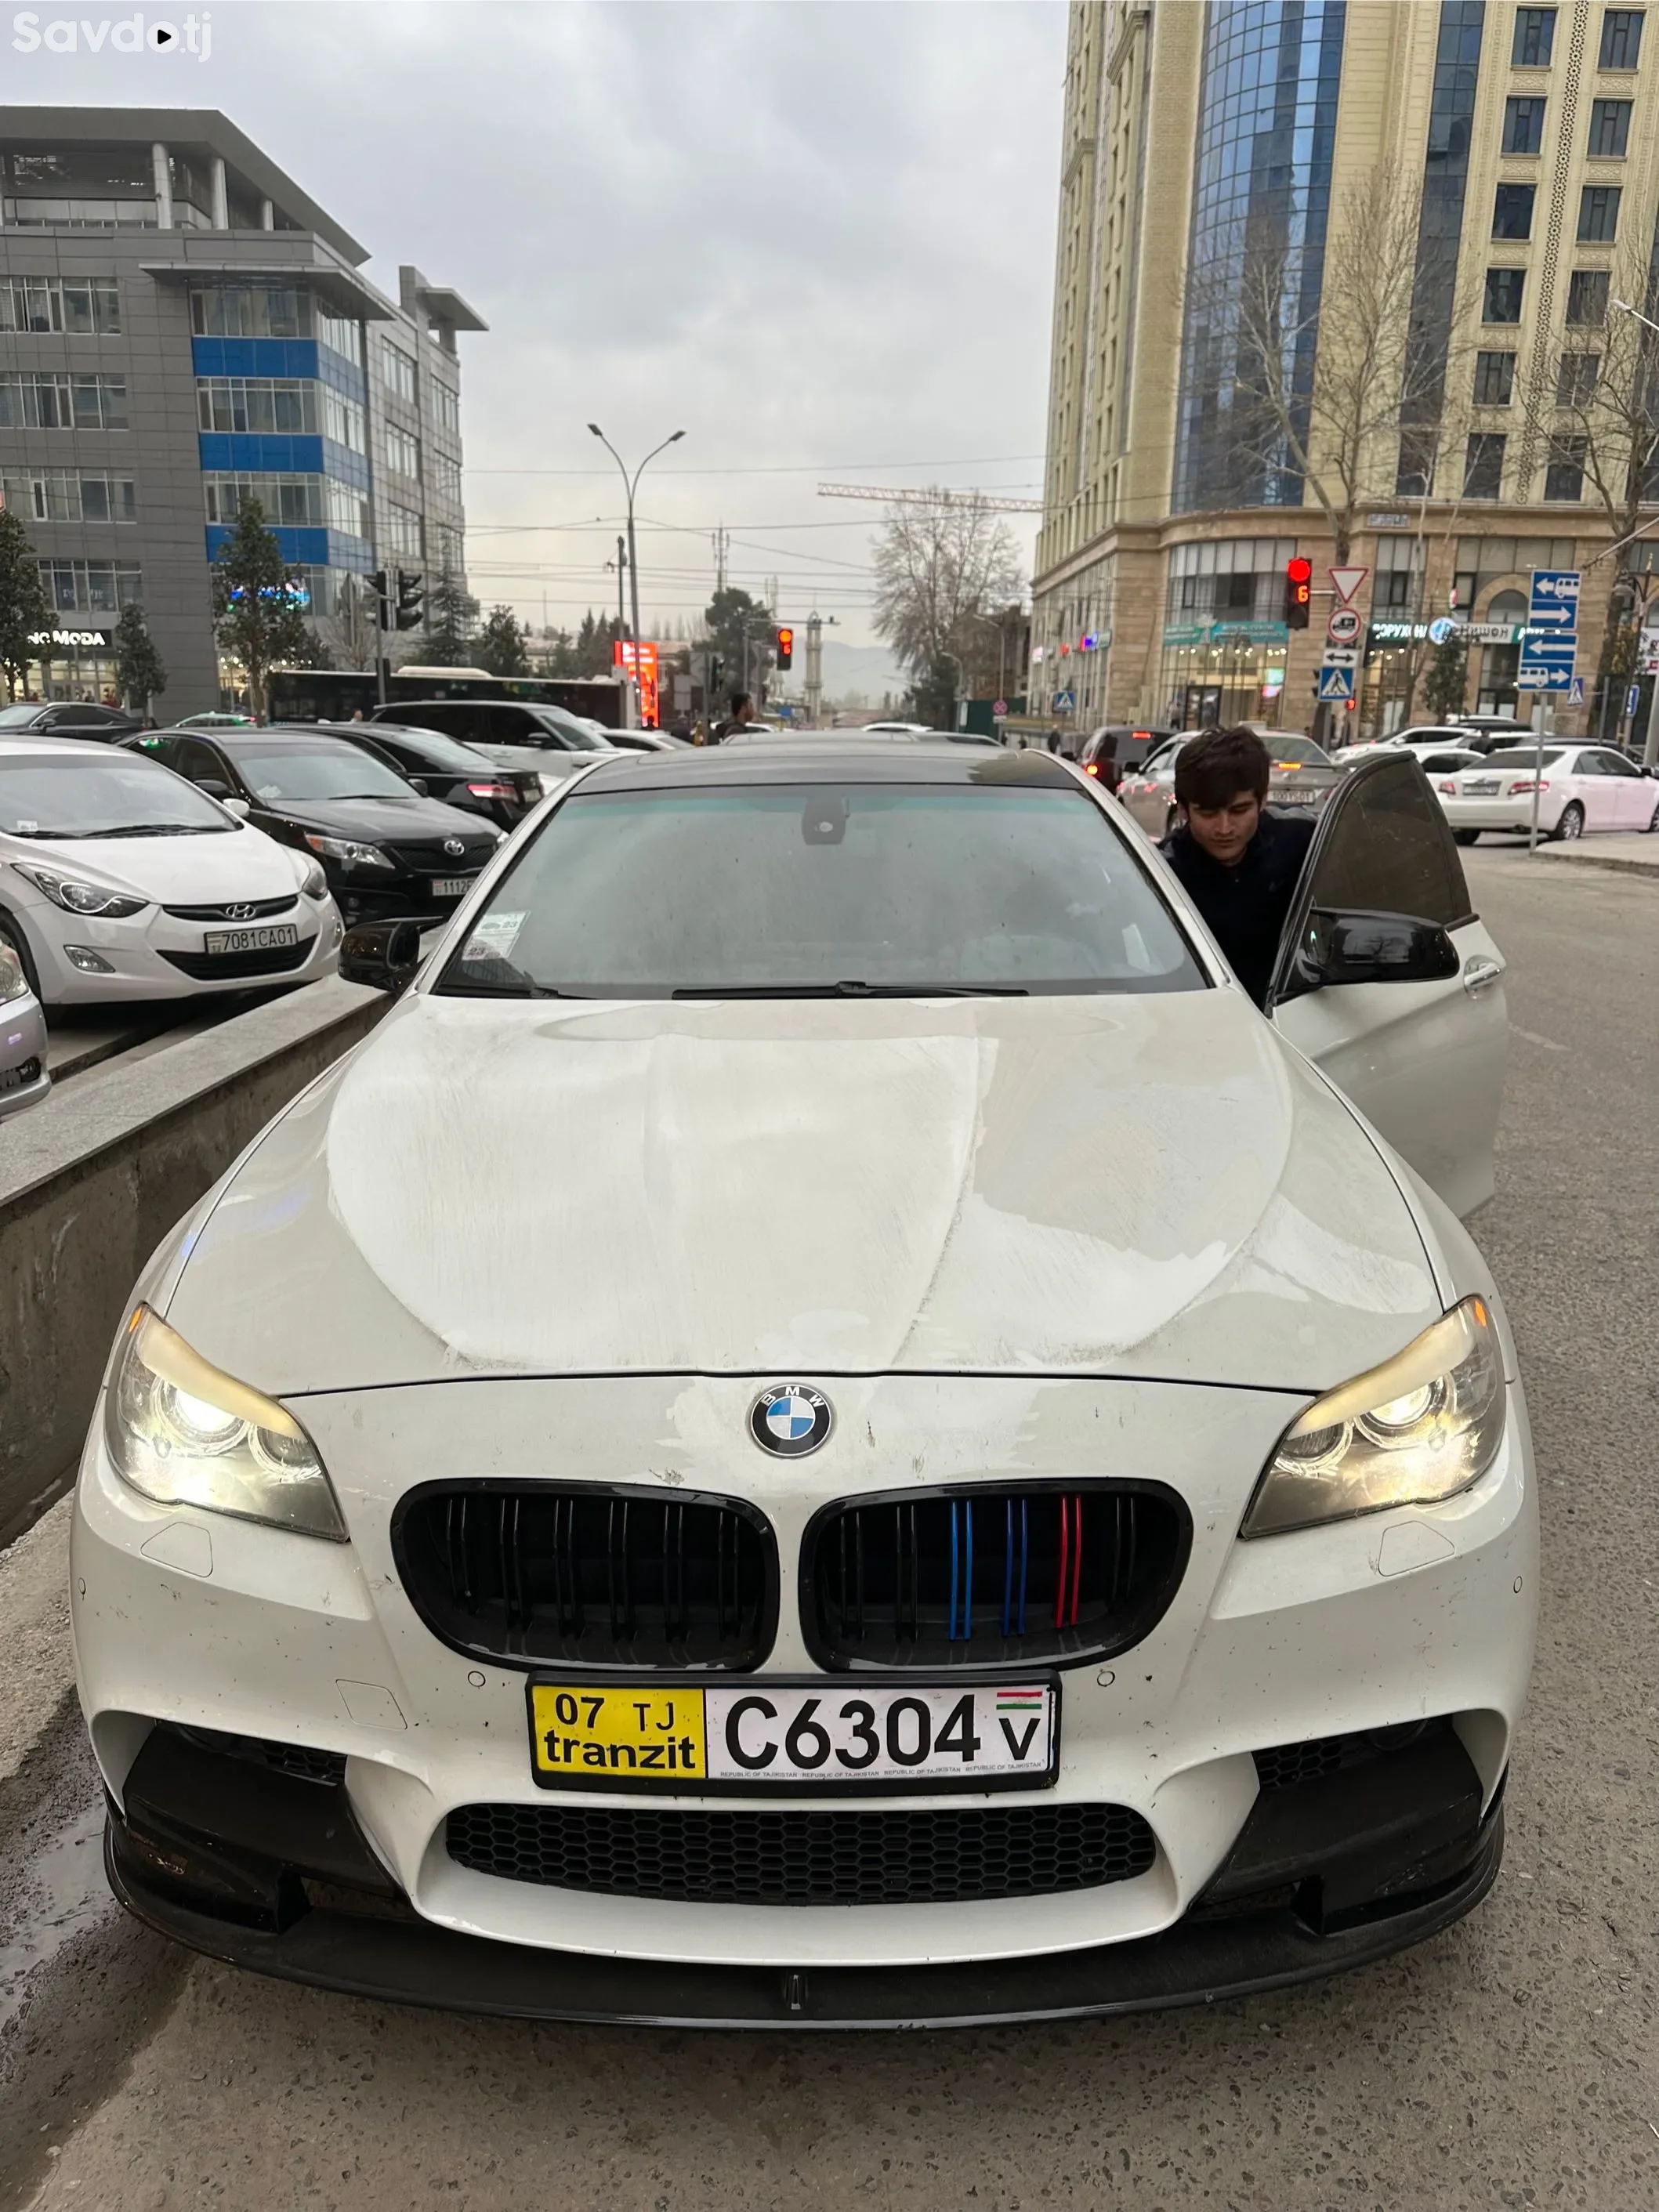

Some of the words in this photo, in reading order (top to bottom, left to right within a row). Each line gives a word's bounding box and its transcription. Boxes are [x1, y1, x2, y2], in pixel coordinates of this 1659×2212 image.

[1298, 585, 1308, 603] 6
[53, 630, 106, 646] MODA
[222, 928, 293, 951] 7081CA01
[760, 1386, 825, 1407] BMW
[555, 1692, 605, 1729] 07
[632, 1701, 675, 1732] TJ
[725, 1694, 981, 1770] C6304
[543, 1729, 696, 1770] tranzit
